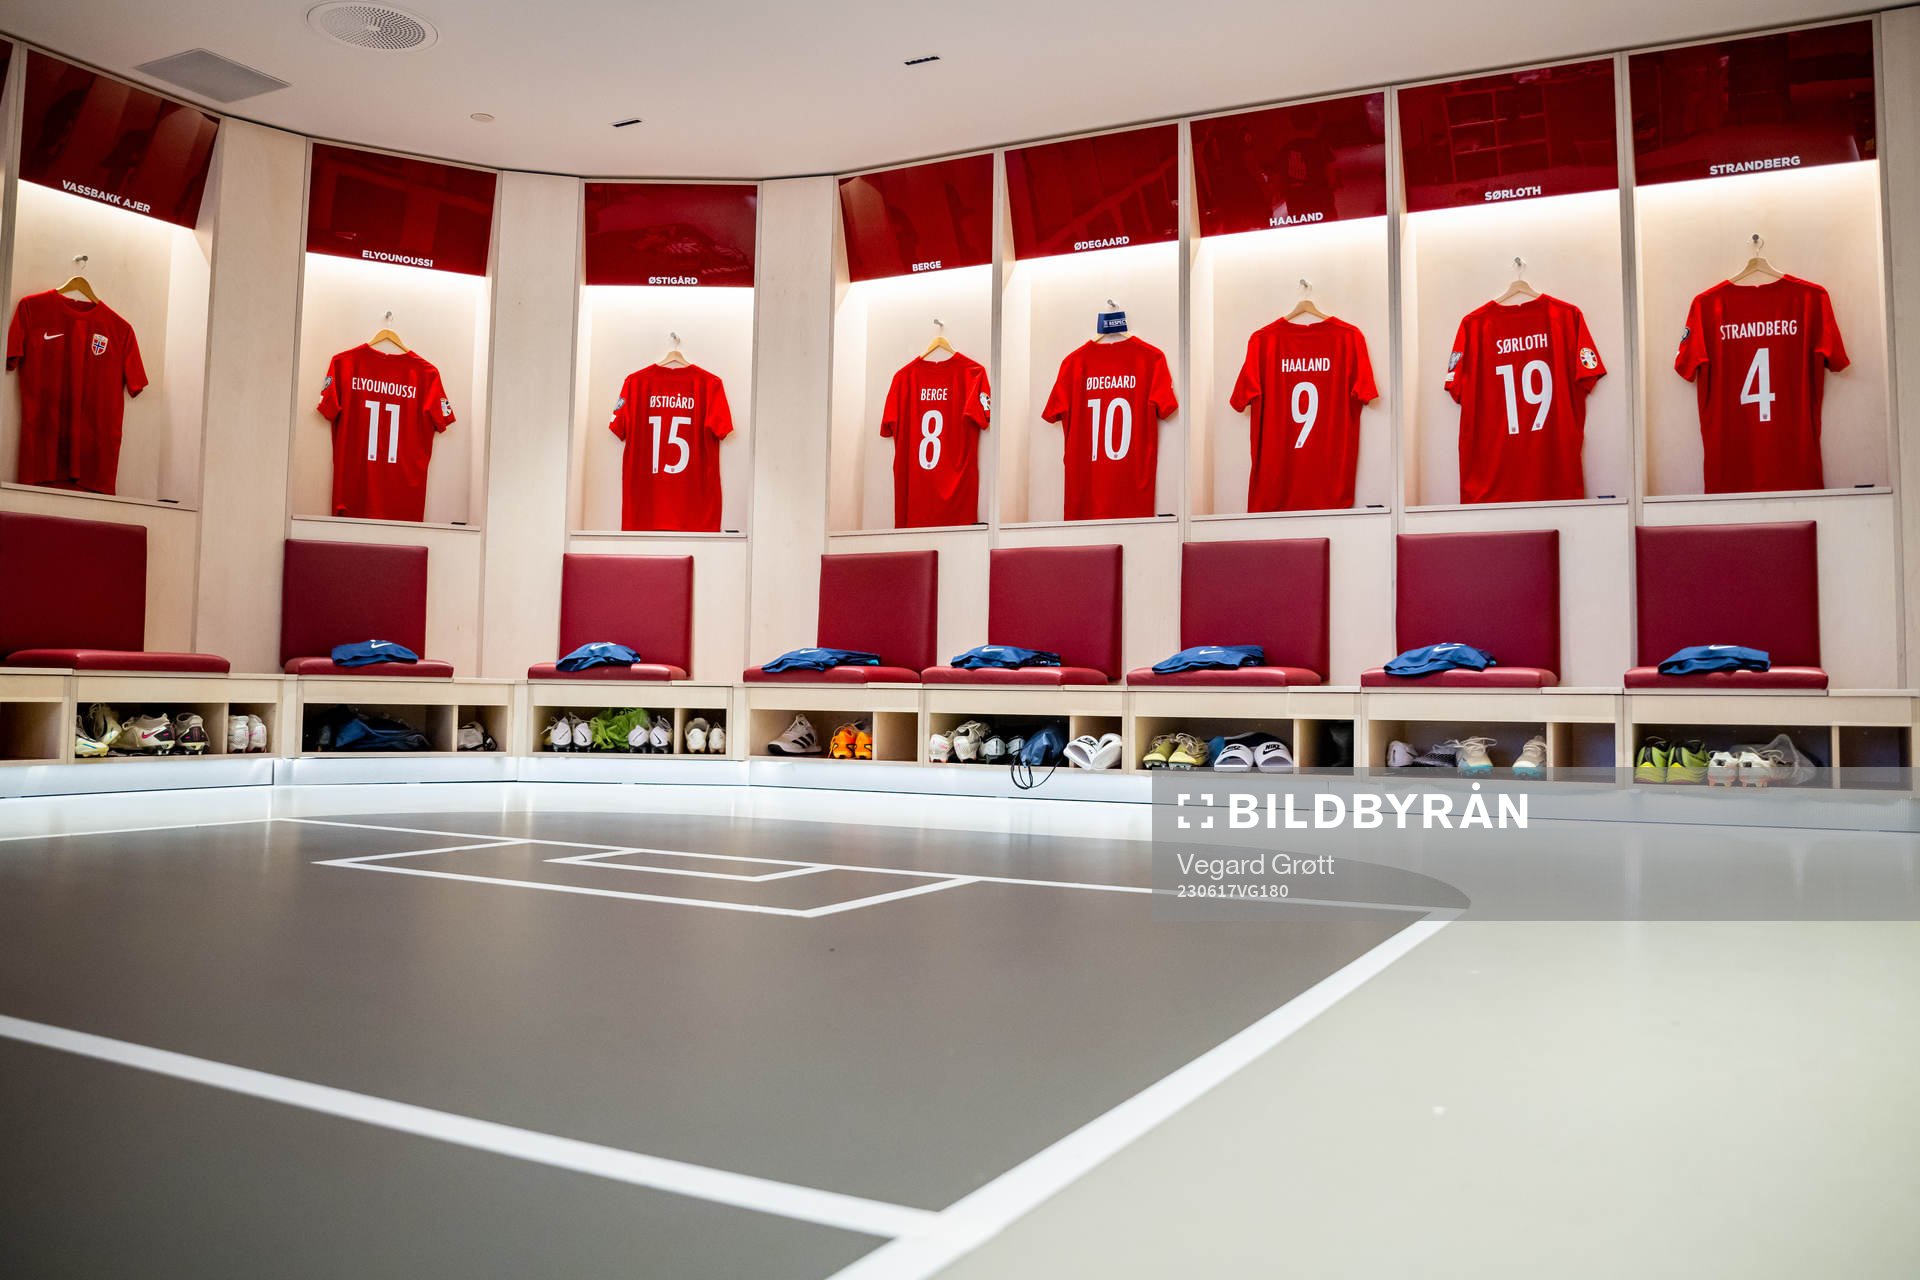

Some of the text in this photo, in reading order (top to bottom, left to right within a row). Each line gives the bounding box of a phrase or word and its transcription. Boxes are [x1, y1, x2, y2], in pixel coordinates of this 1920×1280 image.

[1709, 155, 1801, 175] STRANDBERG
[62, 179, 151, 213] VASSBAKK AJER
[1484, 185, 1542, 201] SØRLOTH
[1269, 212, 1324, 227] HAALAND
[1074, 235, 1130, 252] ØDEGAARD
[362, 250, 433, 267] ELYOUNOUSSI
[912, 260, 942, 272] BERGE
[648, 275, 698, 285] ØSTIGÅRD
[1720, 319, 1798, 341] STRANDBERG
[1496, 333, 1549, 355] SØRLOTH
[1281, 357, 1330, 373] HAALAND
[352, 377, 417, 399] ELYOUNOUSSI
[1086, 374, 1136, 391] ØDEGAARD
[1740, 347, 1776, 422] 4
[650, 393, 695, 410] ØSTIGÅRD
[920, 388, 948, 401] BERGE
[1495, 360, 1553, 435] 19
[1291, 381, 1319, 449] 9
[365, 400, 400, 463] 11
[918, 409, 944, 471] 8
[1087, 397, 1133, 462] 10
[648, 416, 692, 474] 15
